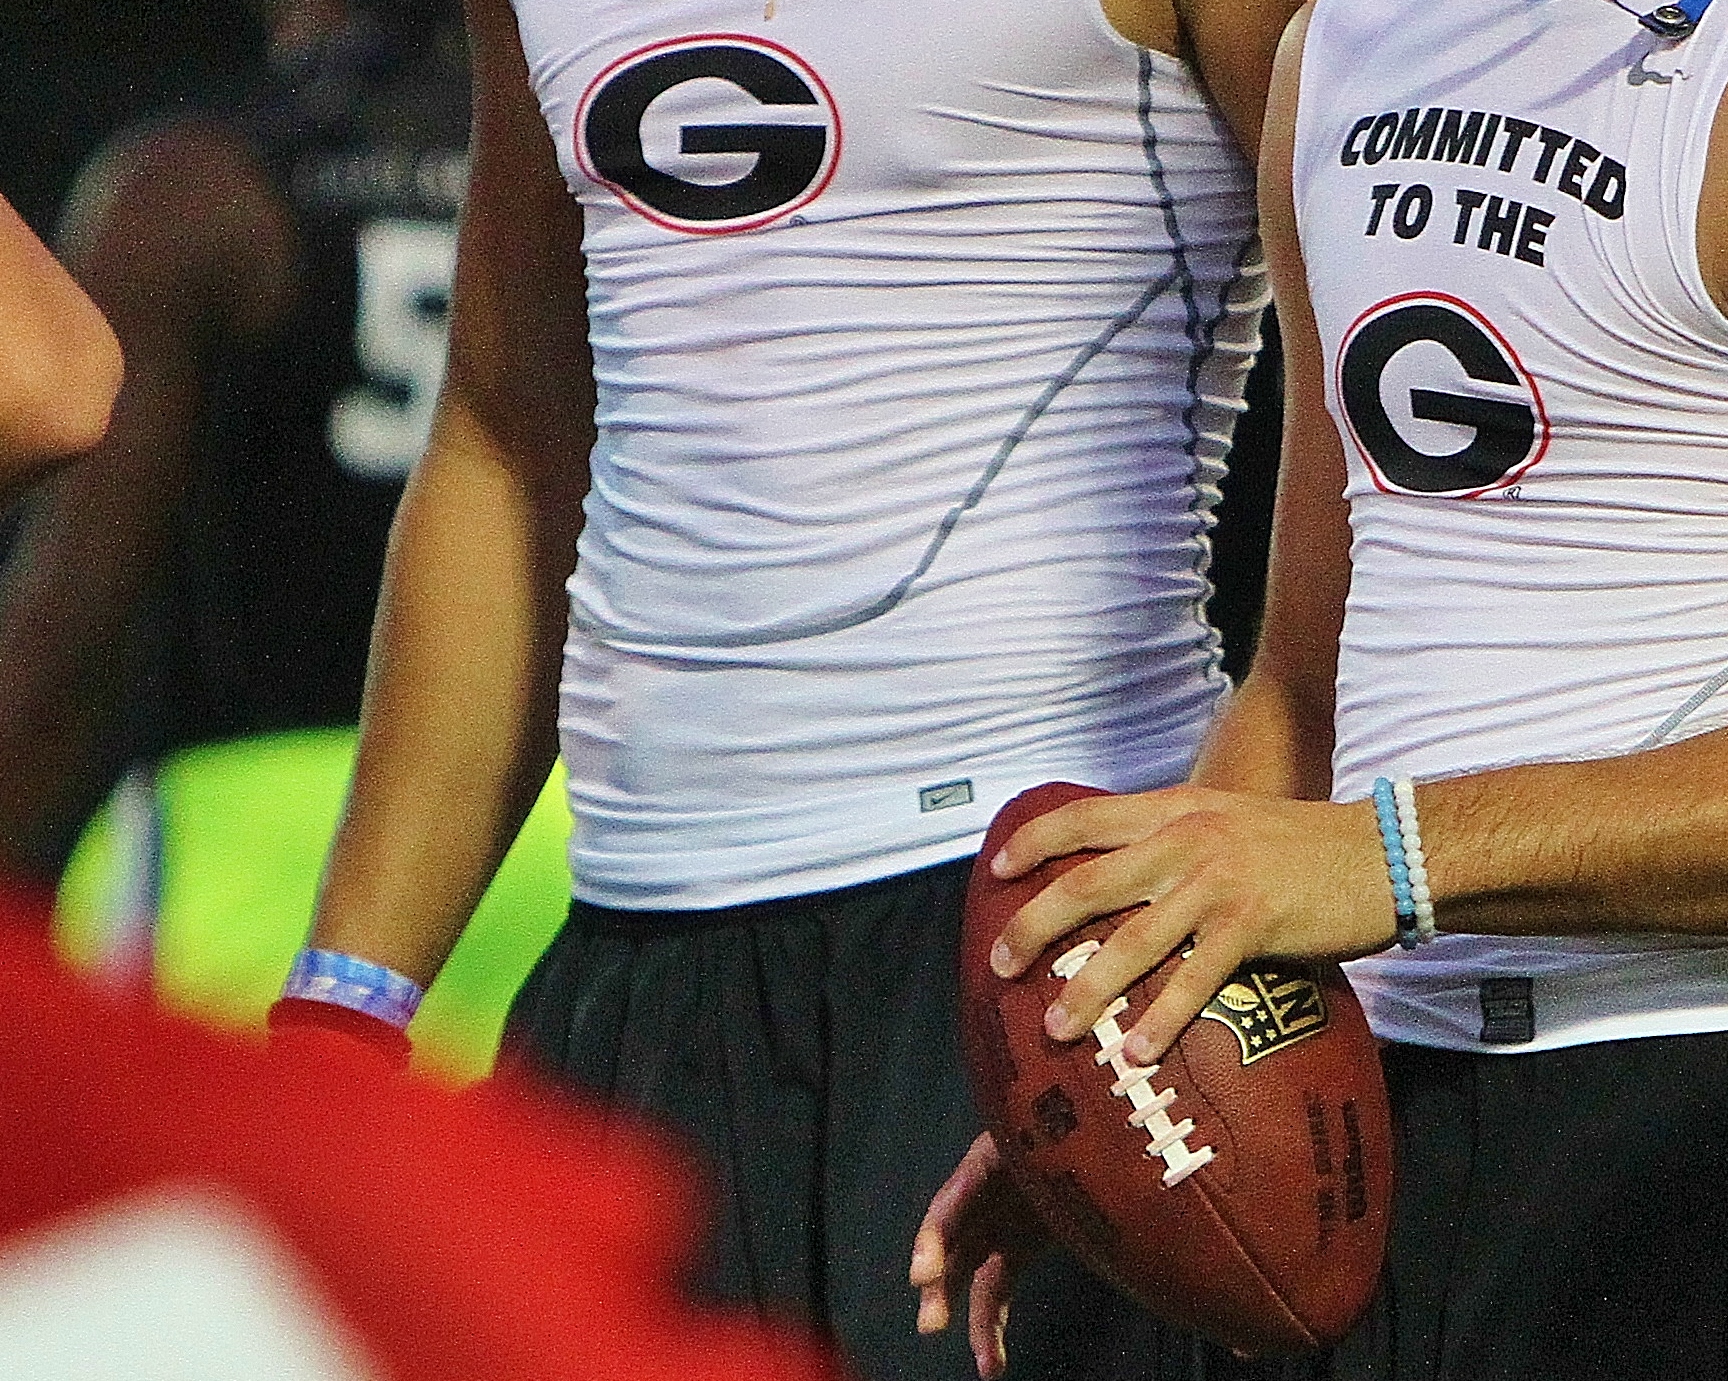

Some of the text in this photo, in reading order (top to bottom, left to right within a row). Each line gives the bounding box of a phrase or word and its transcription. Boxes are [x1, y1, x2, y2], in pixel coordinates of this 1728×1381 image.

[585, 44, 828, 221] G
[1340, 107, 1627, 220] COMMITTED
[1365, 183, 1556, 268] TO THE
[1341, 304, 1536, 493] G
